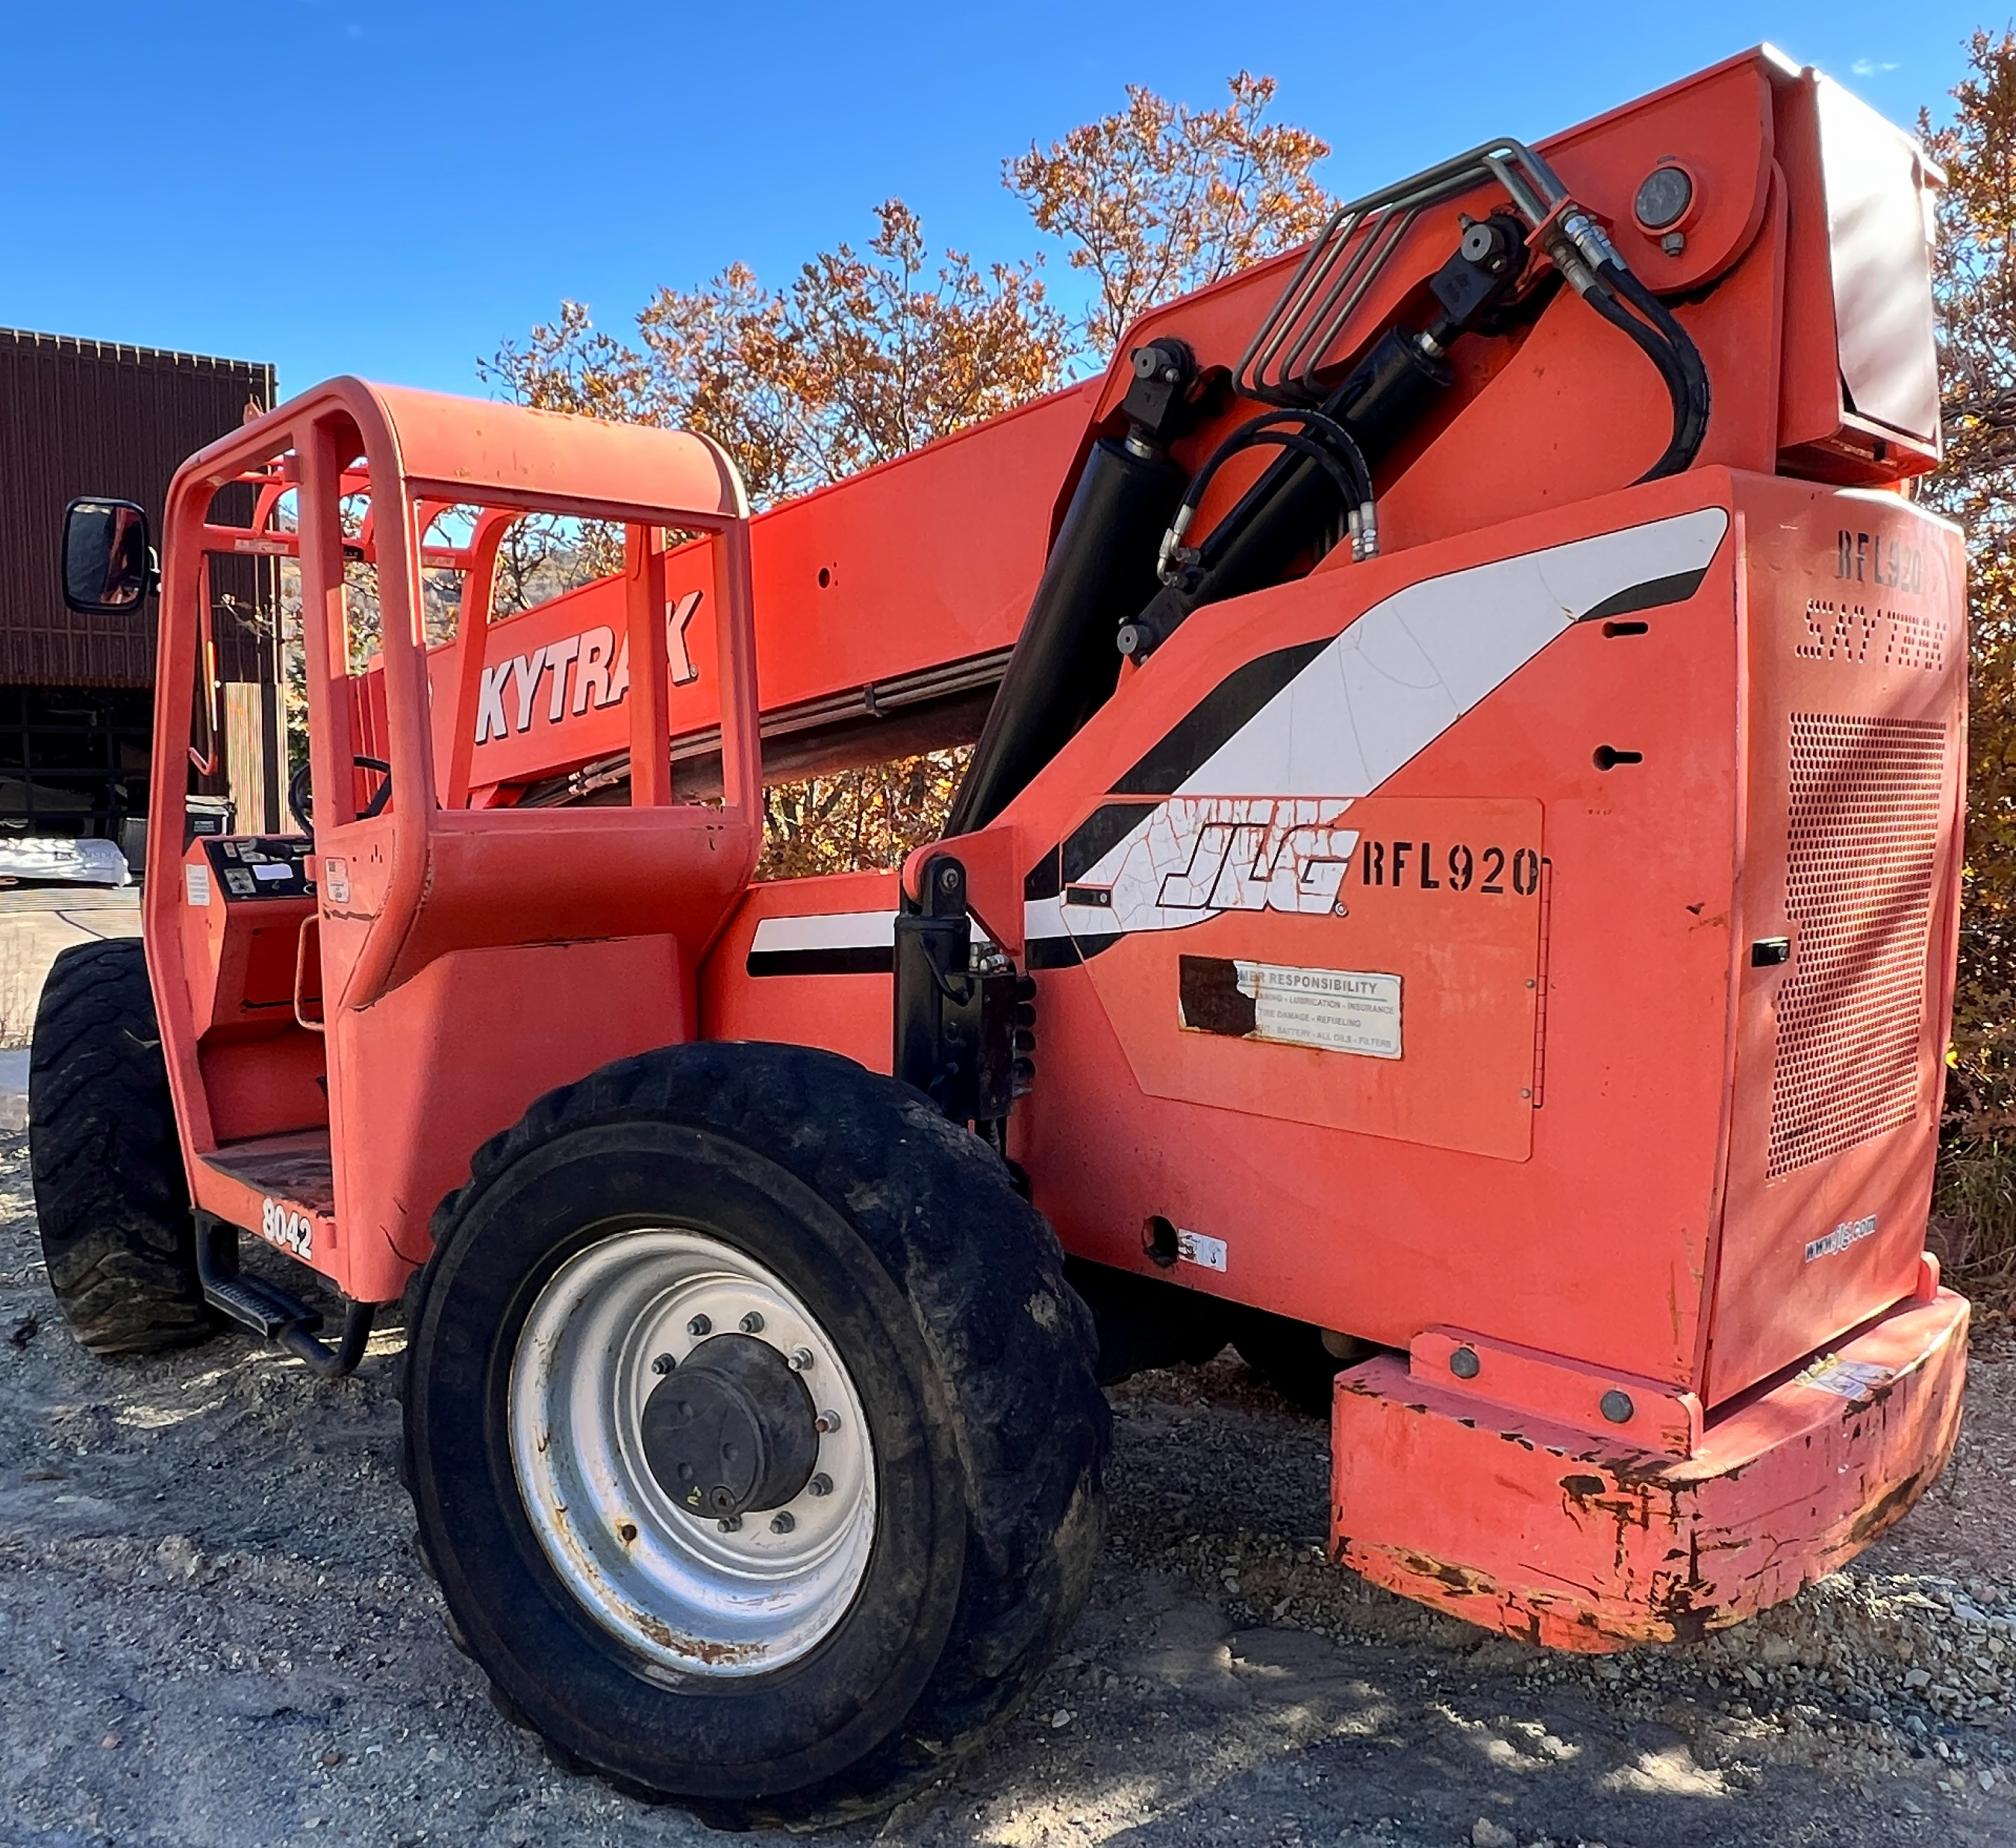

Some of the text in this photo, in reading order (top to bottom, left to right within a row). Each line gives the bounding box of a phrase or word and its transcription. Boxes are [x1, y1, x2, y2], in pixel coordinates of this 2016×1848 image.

[1837, 529, 1922, 594] RFL920
[1156, 822, 1360, 914] JLG
[1363, 841, 1538, 896] RFL920
[1239, 969, 1378, 994] MER RESPONSIBILITY
[1276, 1026, 1311, 1039] BATTERY
[1316, 1032, 1332, 1041] ALL
[1277, 1009, 1310, 1022] DAMAGE
[1316, 1015, 1361, 1028] REFUELING
[262, 1197, 313, 1261] 8042
[1806, 1215, 1877, 1262] www.jlg.com
